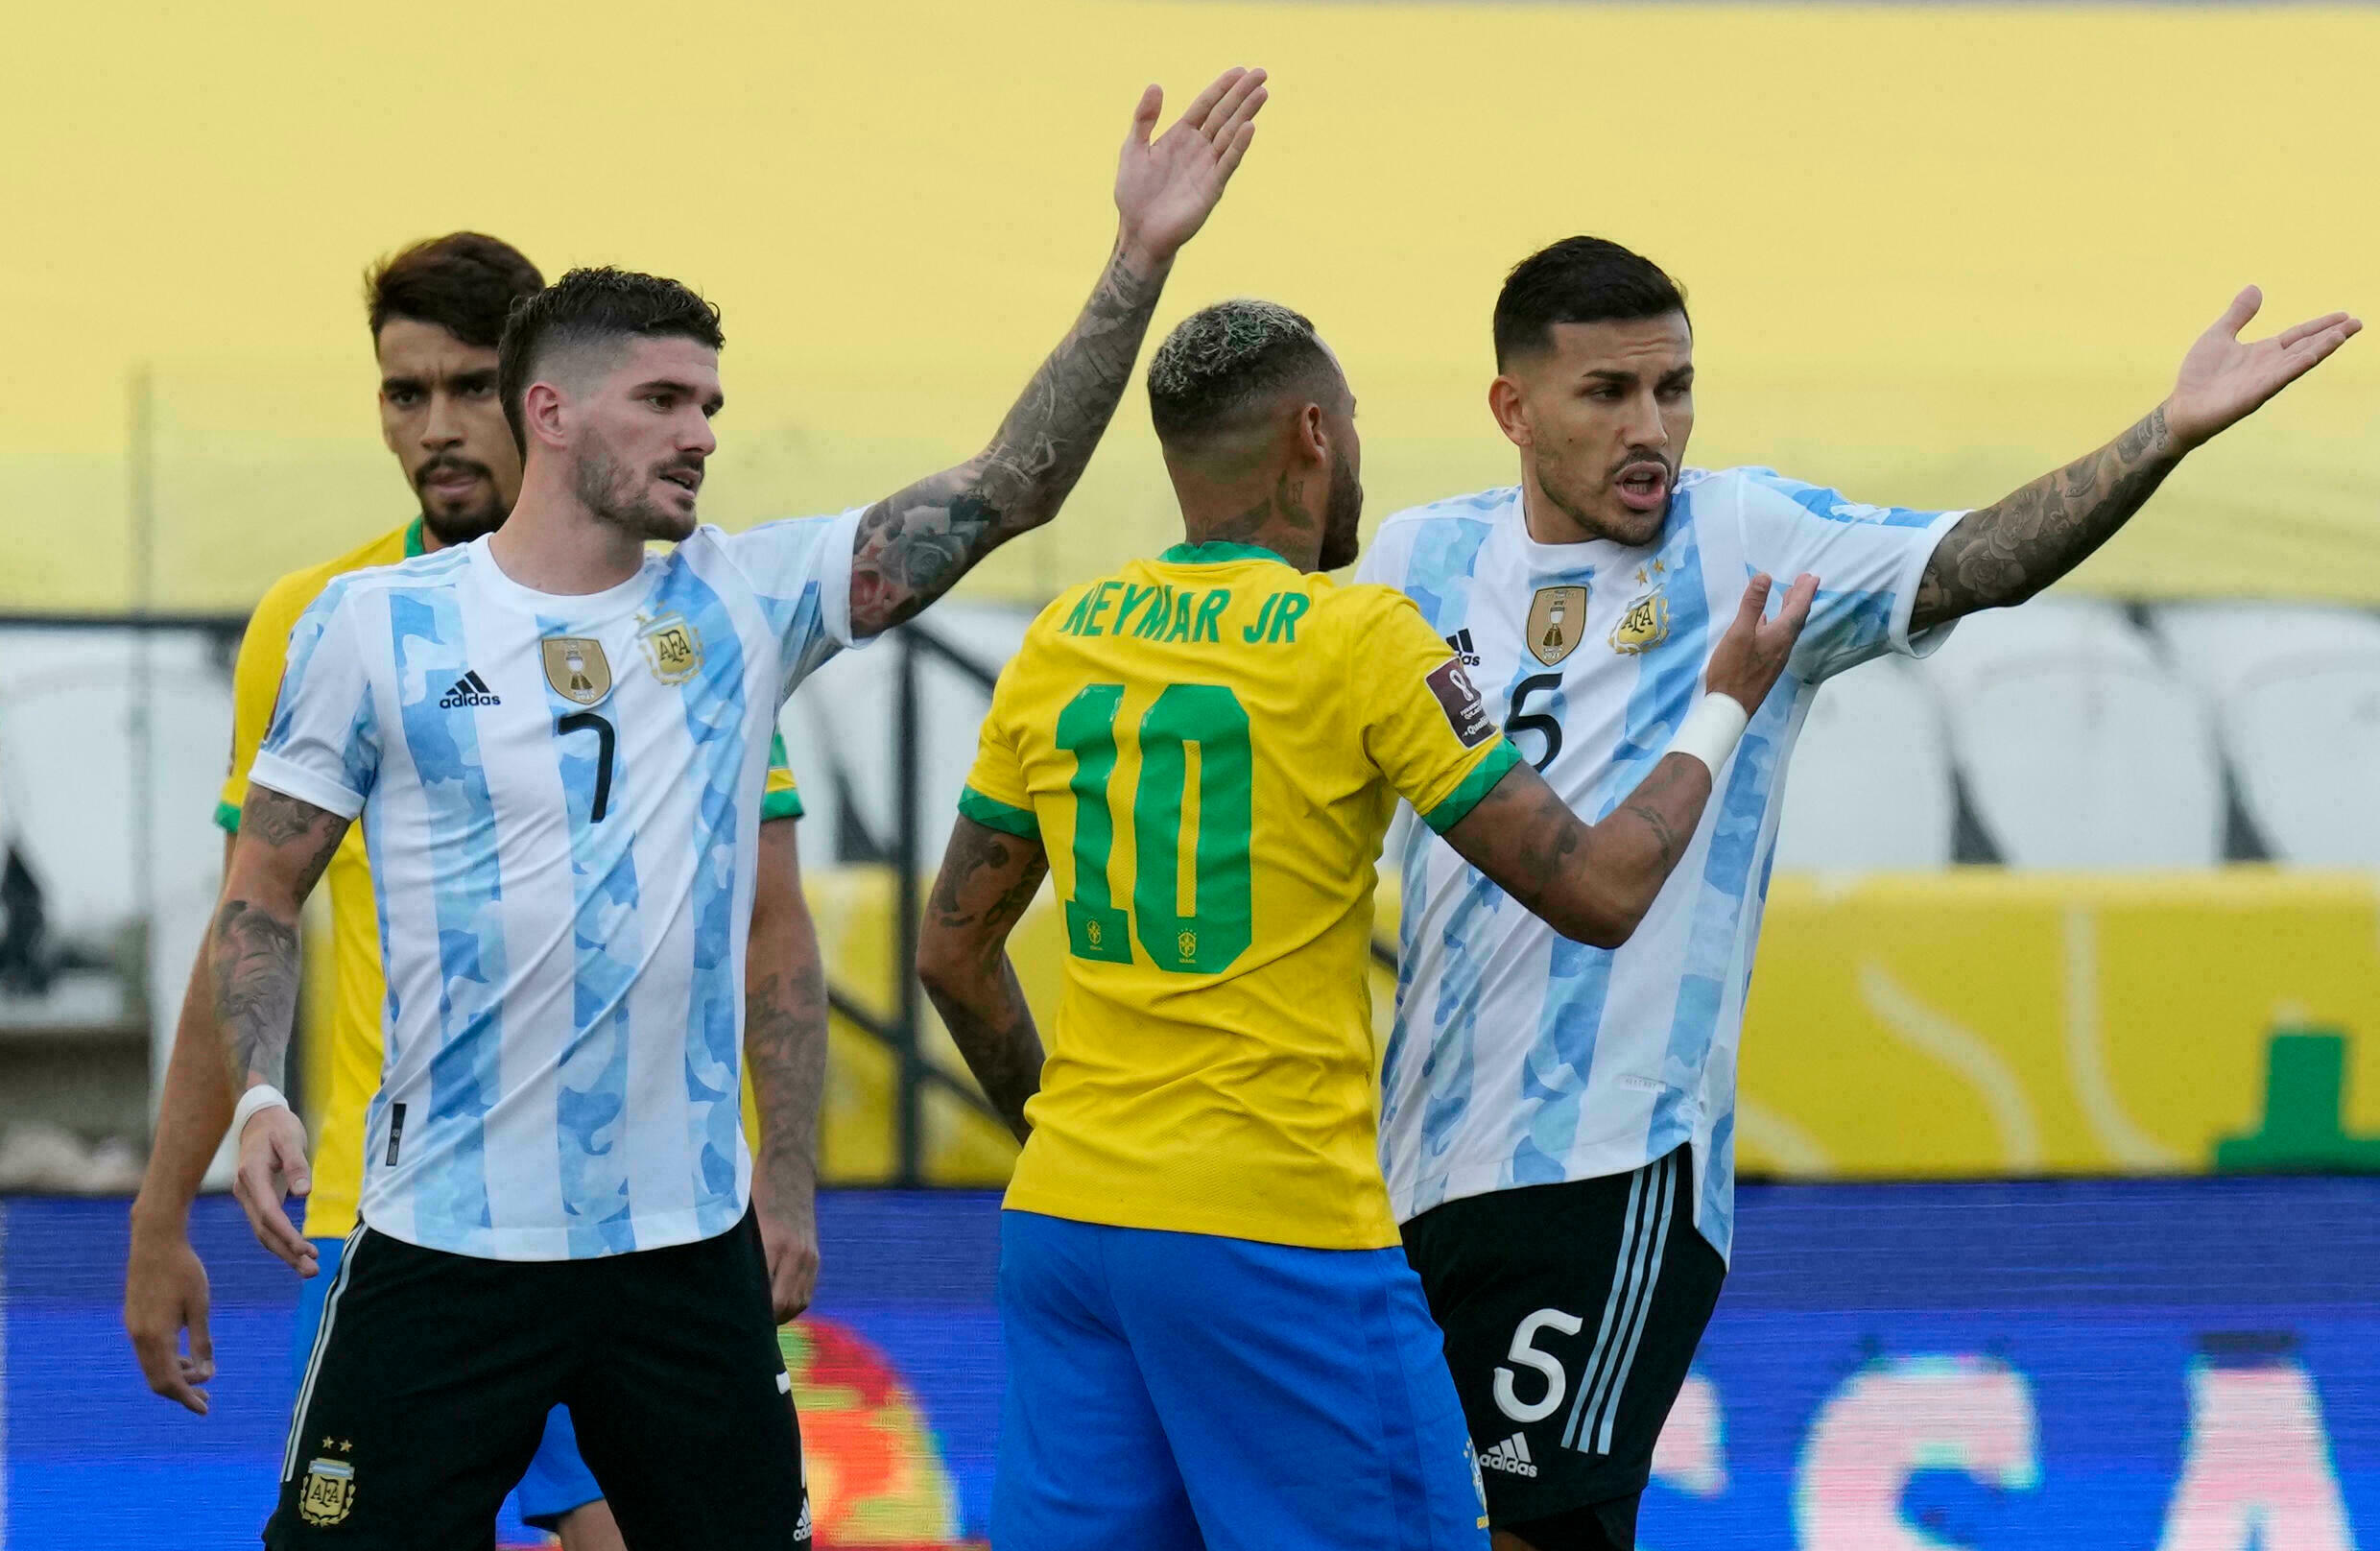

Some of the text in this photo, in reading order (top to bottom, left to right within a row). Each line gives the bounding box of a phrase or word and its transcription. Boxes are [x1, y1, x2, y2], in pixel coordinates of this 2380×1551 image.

[1057, 581, 1311, 644] NEYMAR JR
[439, 692, 502, 710] adidas
[1504, 672, 1563, 774] 5
[558, 713, 615, 823] 7
[1055, 682, 1253, 975] 10
[1492, 1307, 1583, 1423] 5
[1479, 1452, 1538, 1478] adidas
